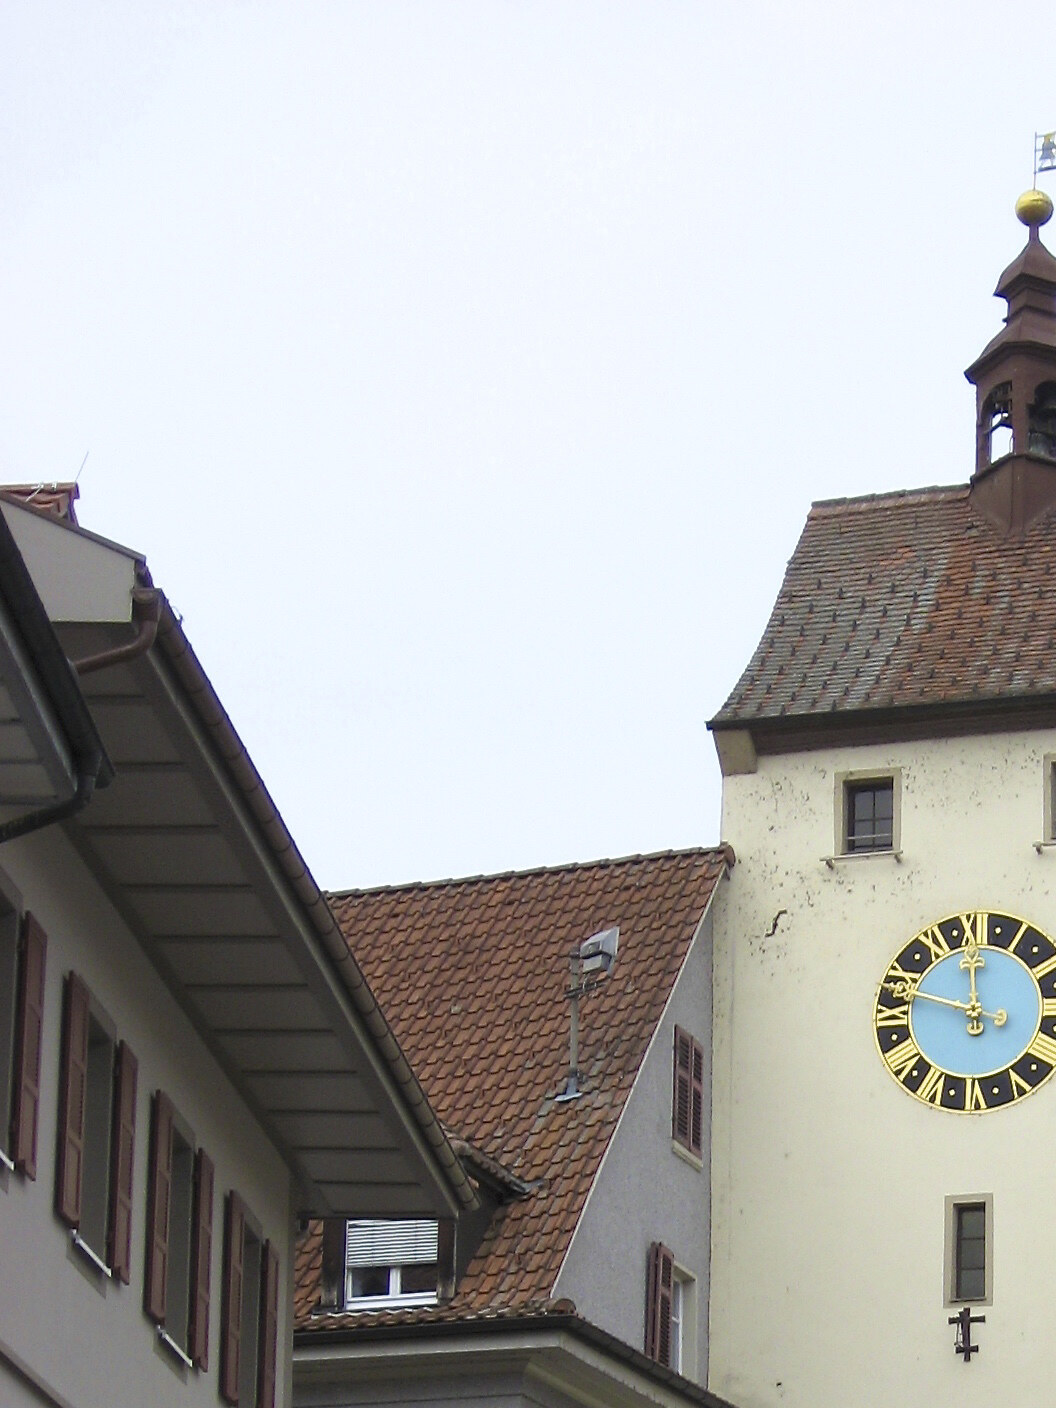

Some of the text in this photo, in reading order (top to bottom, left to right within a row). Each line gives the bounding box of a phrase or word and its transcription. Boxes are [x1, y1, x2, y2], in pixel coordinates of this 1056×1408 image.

[918, 925, 950, 962] XI
[959, 914, 988, 946] XII
[876, 1004, 908, 1028] IX
[884, 1038, 920, 1082] VIII
[916, 1067, 945, 1106] VII
[965, 1078, 987, 1110] VI
[1009, 1069, 1033, 1099] V
